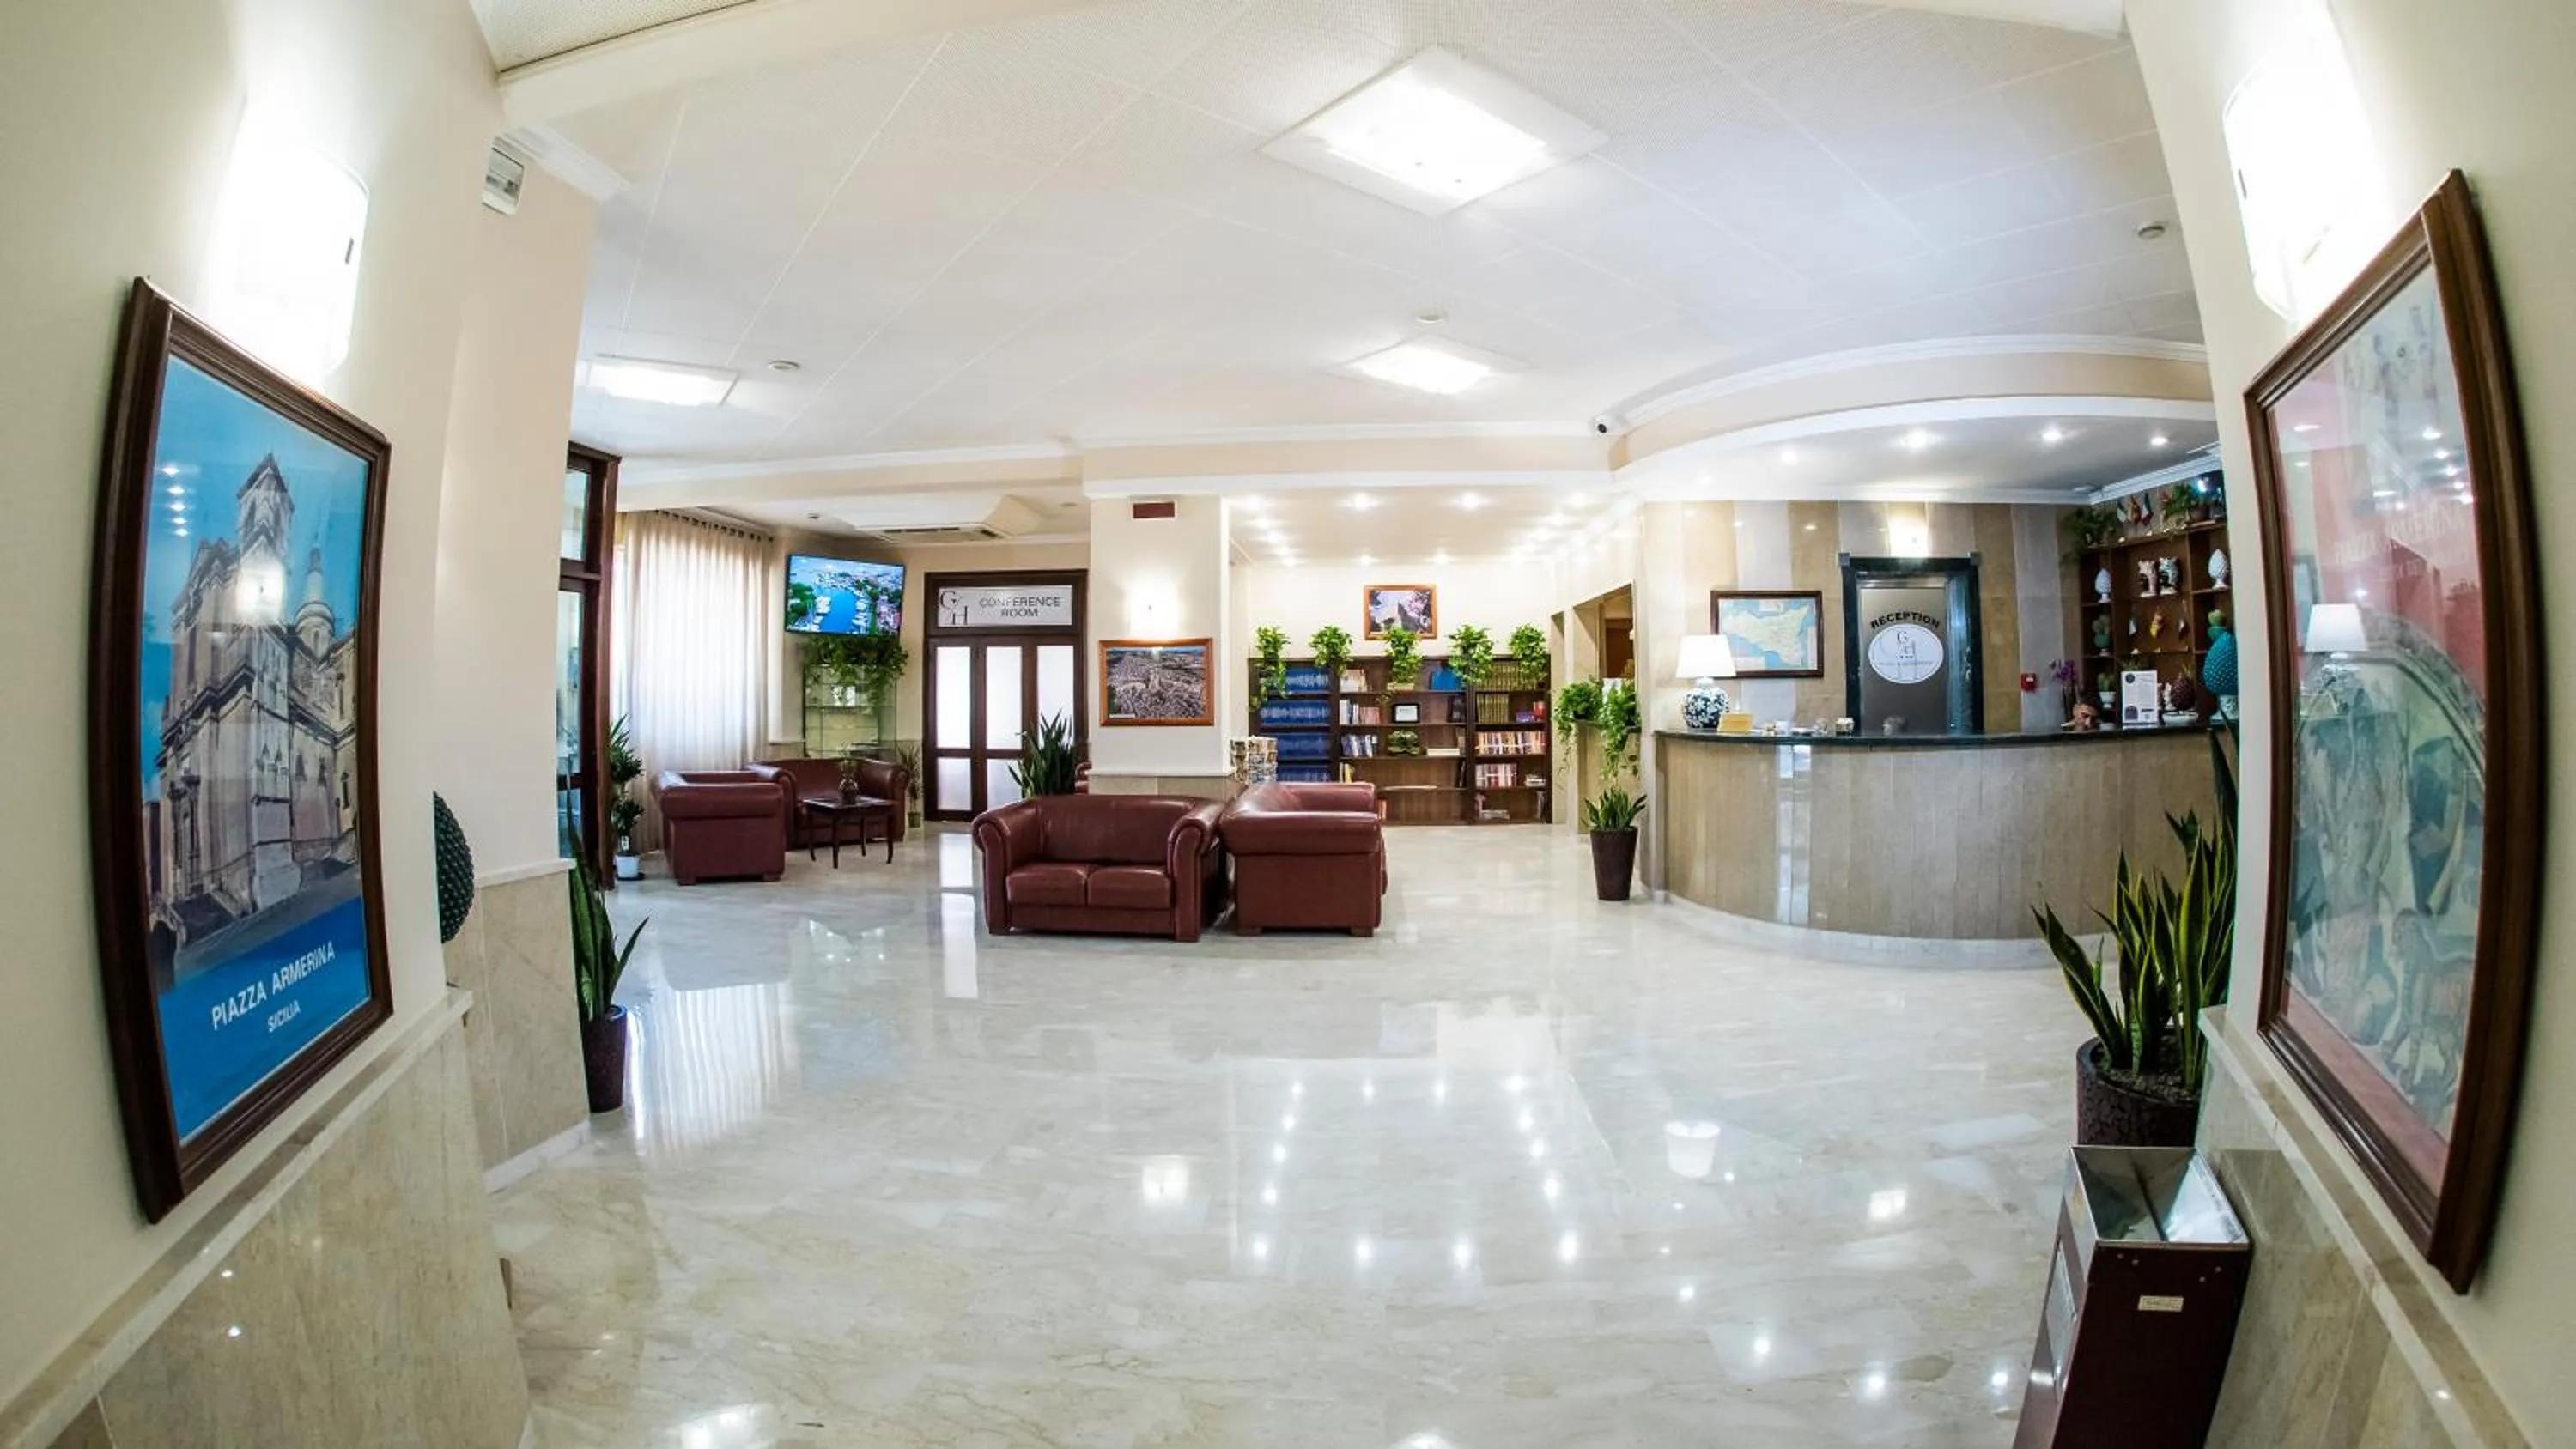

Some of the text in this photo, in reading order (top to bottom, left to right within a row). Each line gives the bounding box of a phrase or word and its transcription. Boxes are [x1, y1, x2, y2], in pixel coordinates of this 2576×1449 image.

[980, 597, 1060, 608] CONFERENCE
[1001, 609, 1038, 617] ROOM
[1870, 611, 1941, 629] RECEPTION
[211, 940, 336, 1031] PIAZZA ARMERINA
[267, 999, 301, 1033] SICILIA
